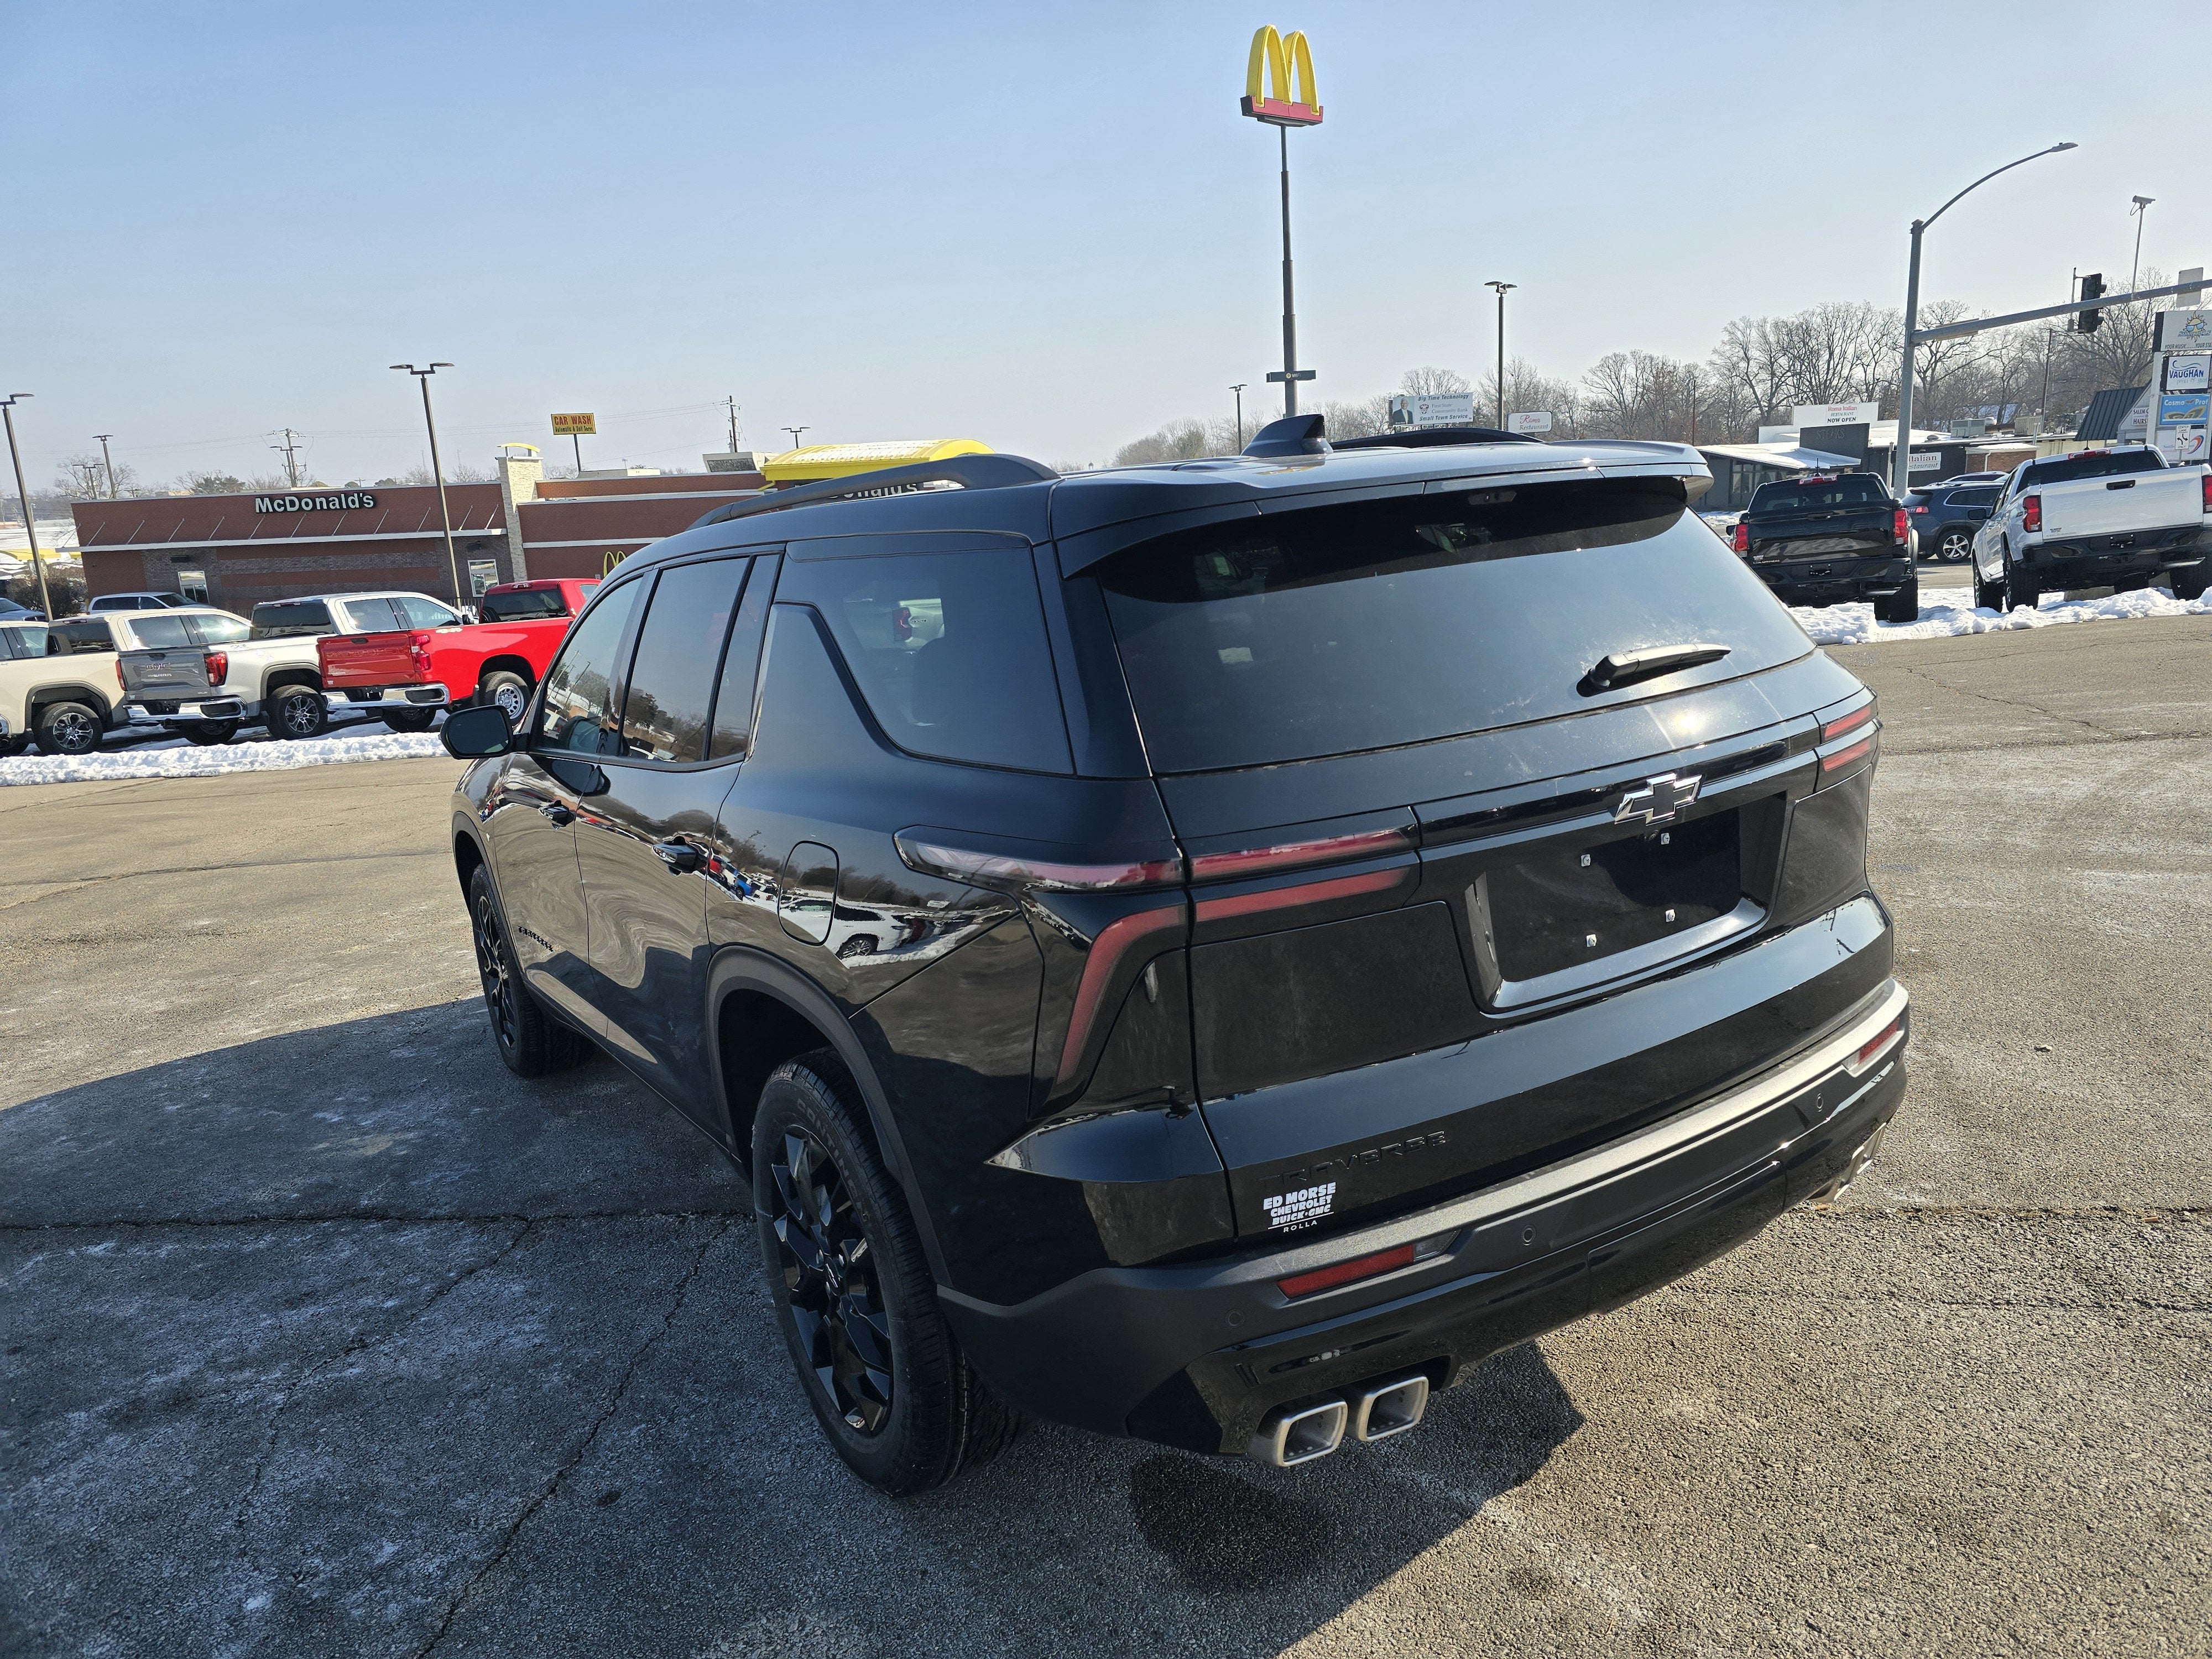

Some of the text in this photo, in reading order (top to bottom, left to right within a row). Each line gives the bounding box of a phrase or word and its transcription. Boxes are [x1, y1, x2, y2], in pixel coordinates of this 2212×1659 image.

[2169, 369, 2204, 378] VAUGHAN
[554, 415, 591, 425] CAR WASH
[1520, 415, 1540, 424] Roma
[255, 493, 374, 513] McDonald's
[1263, 1182, 1336, 1210] ED MORSE
[1270, 1195, 1333, 1218] CHEVROLET
[1284, 1220, 1317, 1233] ROLLA
